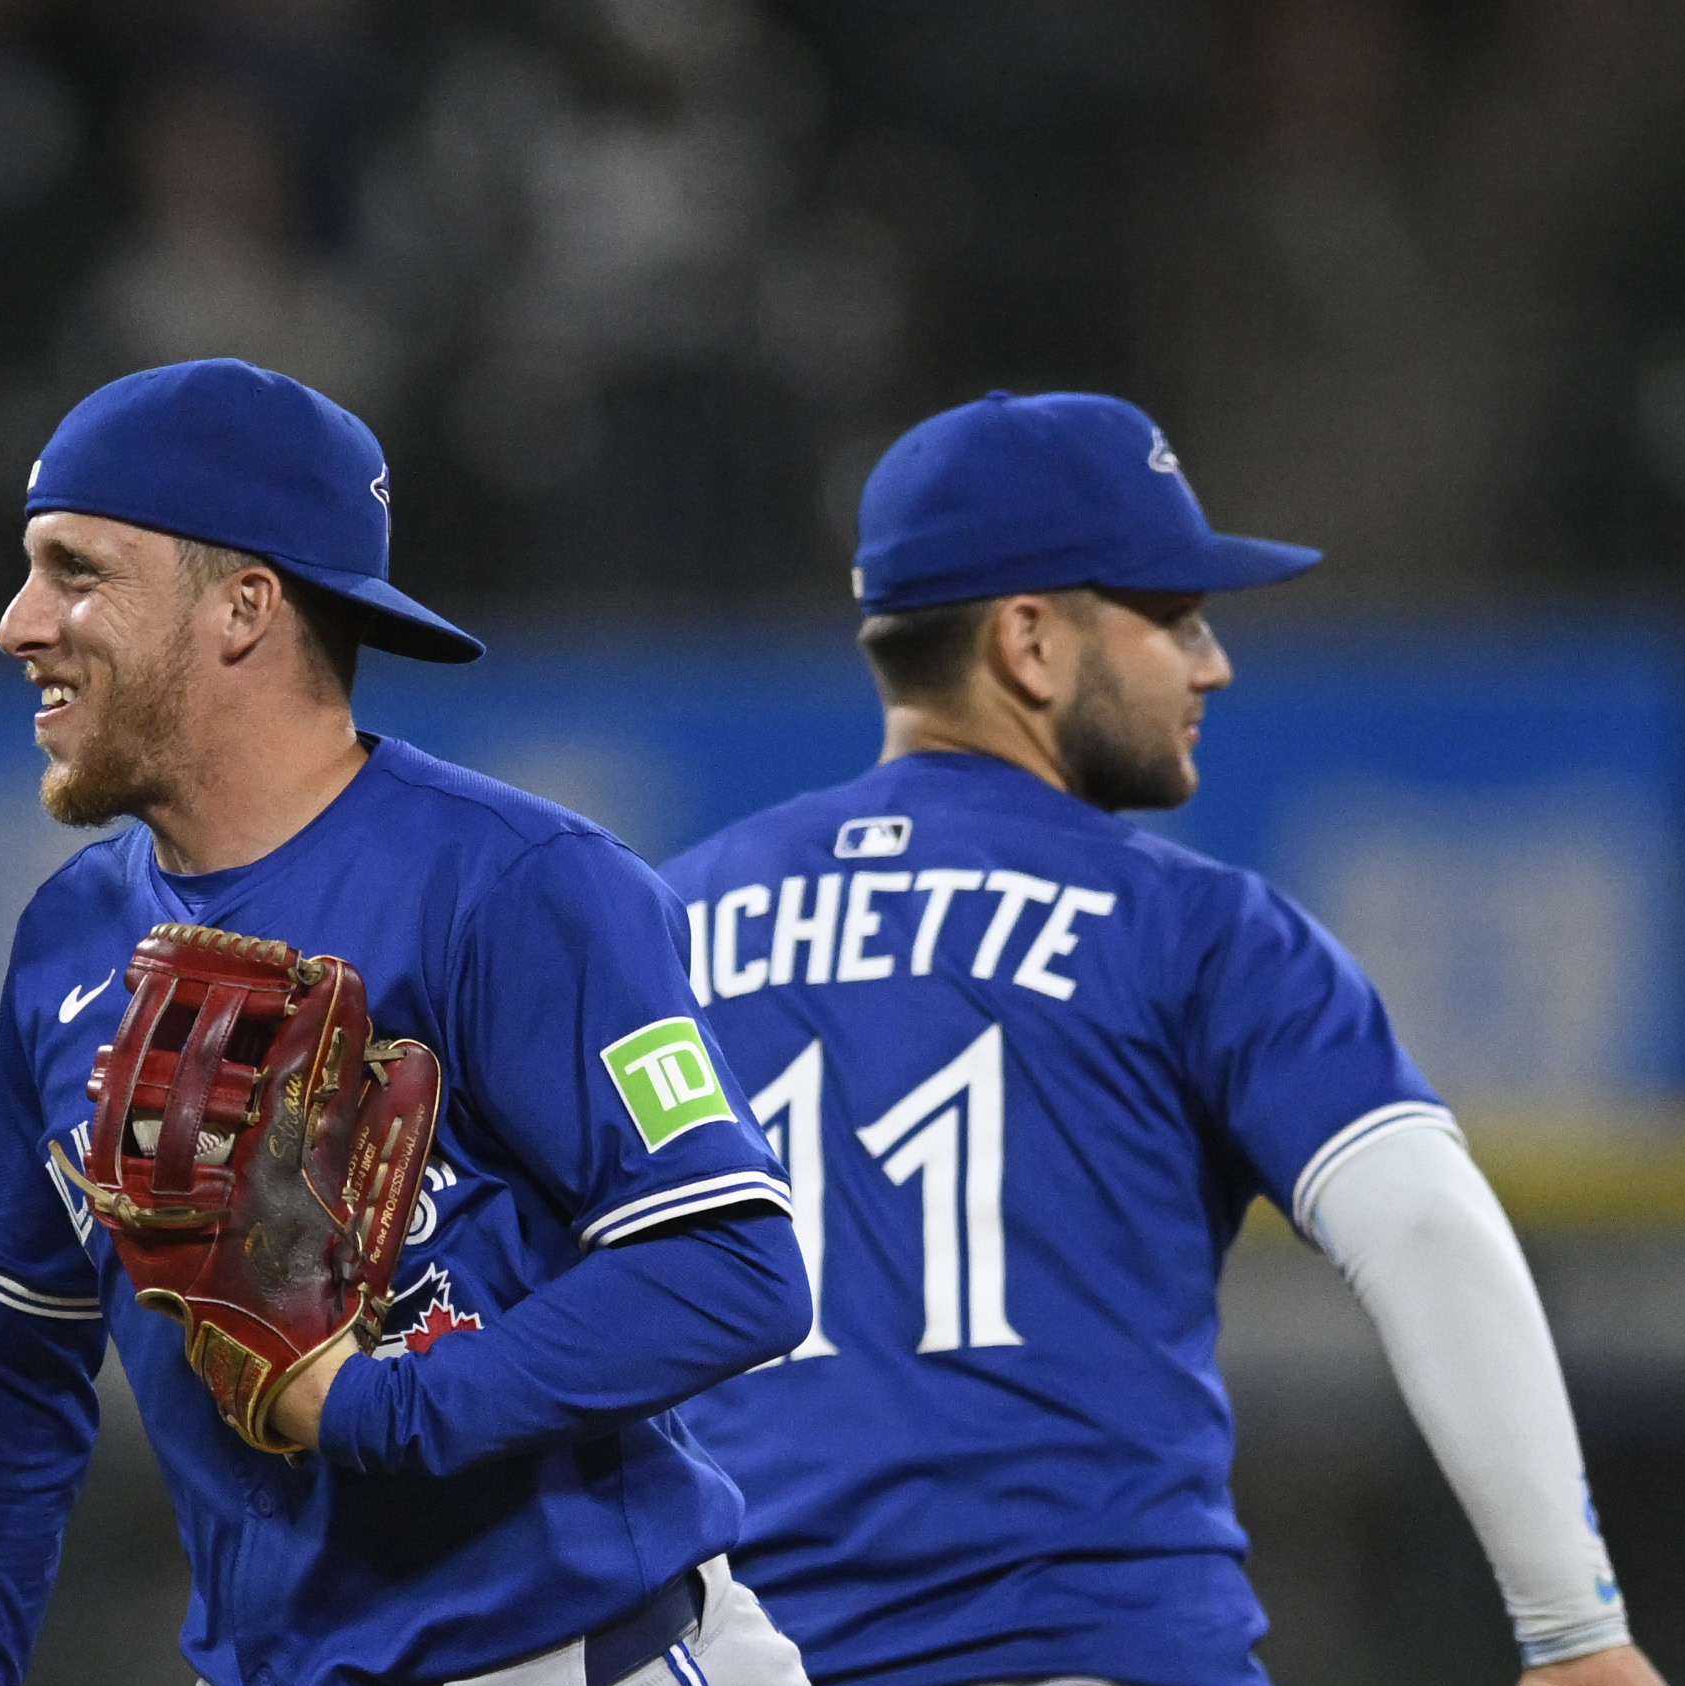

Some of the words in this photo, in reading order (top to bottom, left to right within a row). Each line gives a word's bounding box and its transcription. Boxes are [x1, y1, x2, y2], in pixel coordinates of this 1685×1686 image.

[686, 868, 1116, 1008] ICHETTE
[623, 1040, 716, 1112] TD
[360, 1142, 377, 1172] INCH
[380, 1135, 417, 1229] PROFESSIONAL
[744, 1022, 1025, 1374] 11
[369, 1248, 381, 1265] For
[376, 1228, 388, 1247] the
